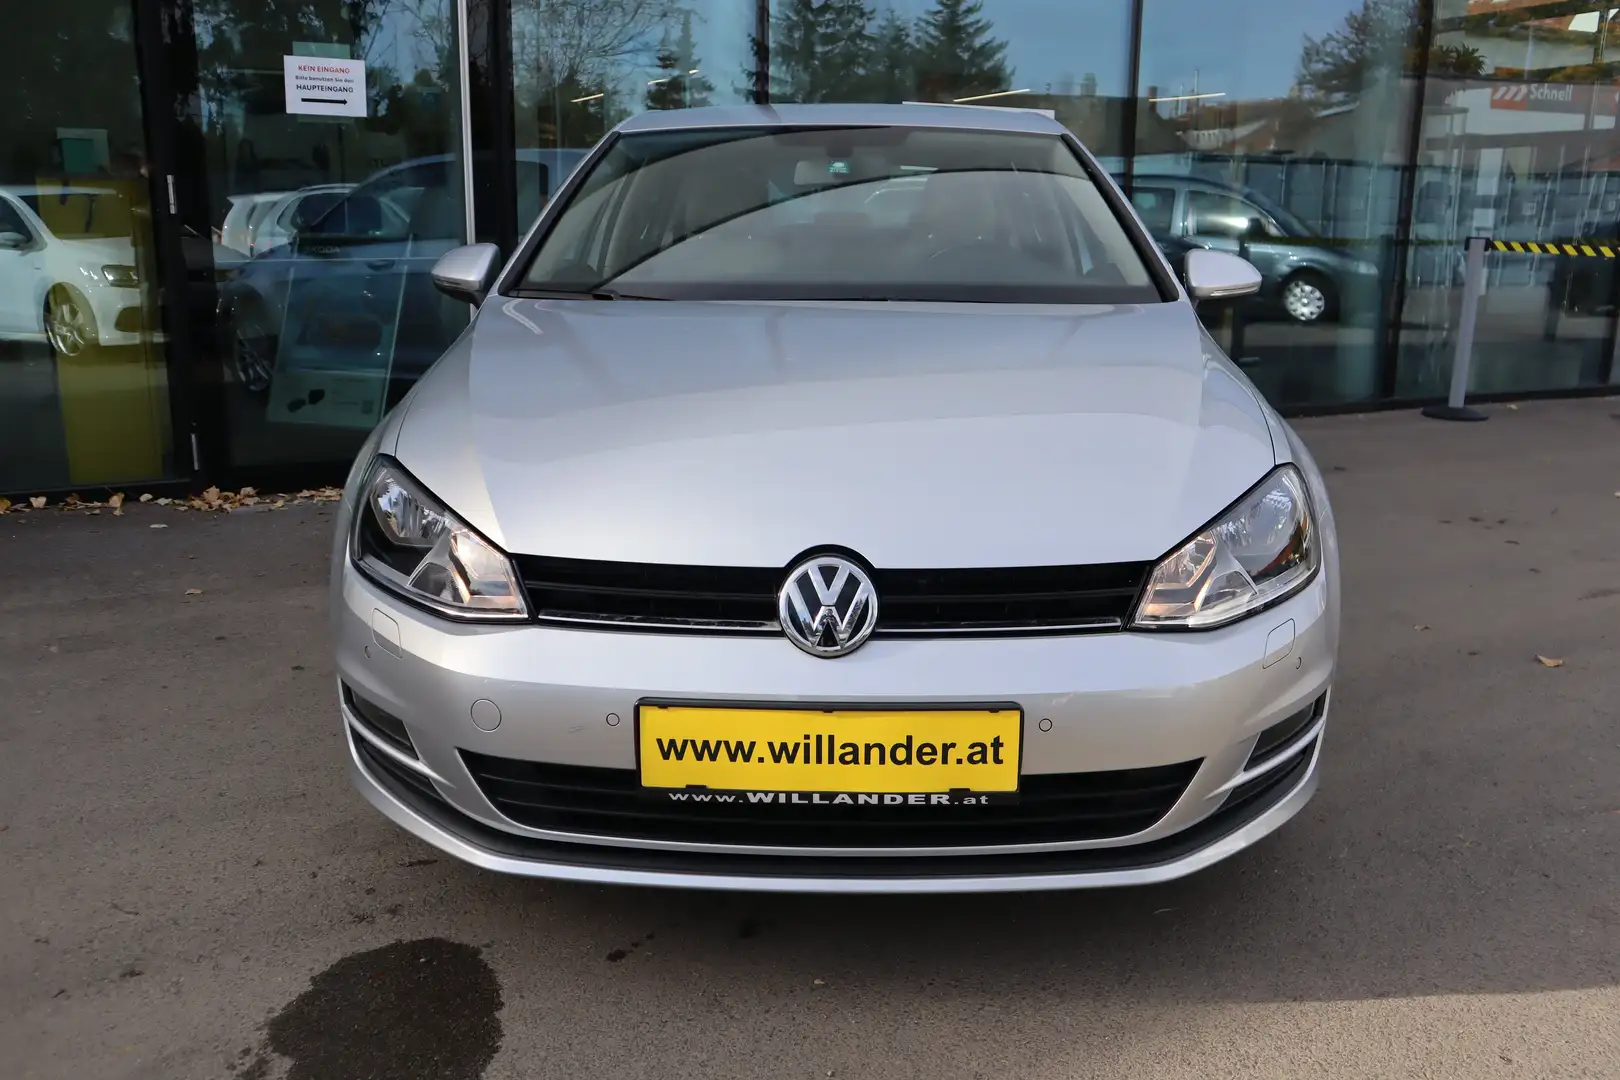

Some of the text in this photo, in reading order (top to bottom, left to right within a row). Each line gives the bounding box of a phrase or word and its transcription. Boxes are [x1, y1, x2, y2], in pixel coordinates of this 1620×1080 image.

[317, 66, 351, 74] EINGANG
[296, 84, 354, 93] HAUPTEINGANG
[1529, 83, 1573, 101] Schnell
[656, 734, 1005, 766] www.willander.at
[668, 791, 990, 806] www.WILLANDER.at
